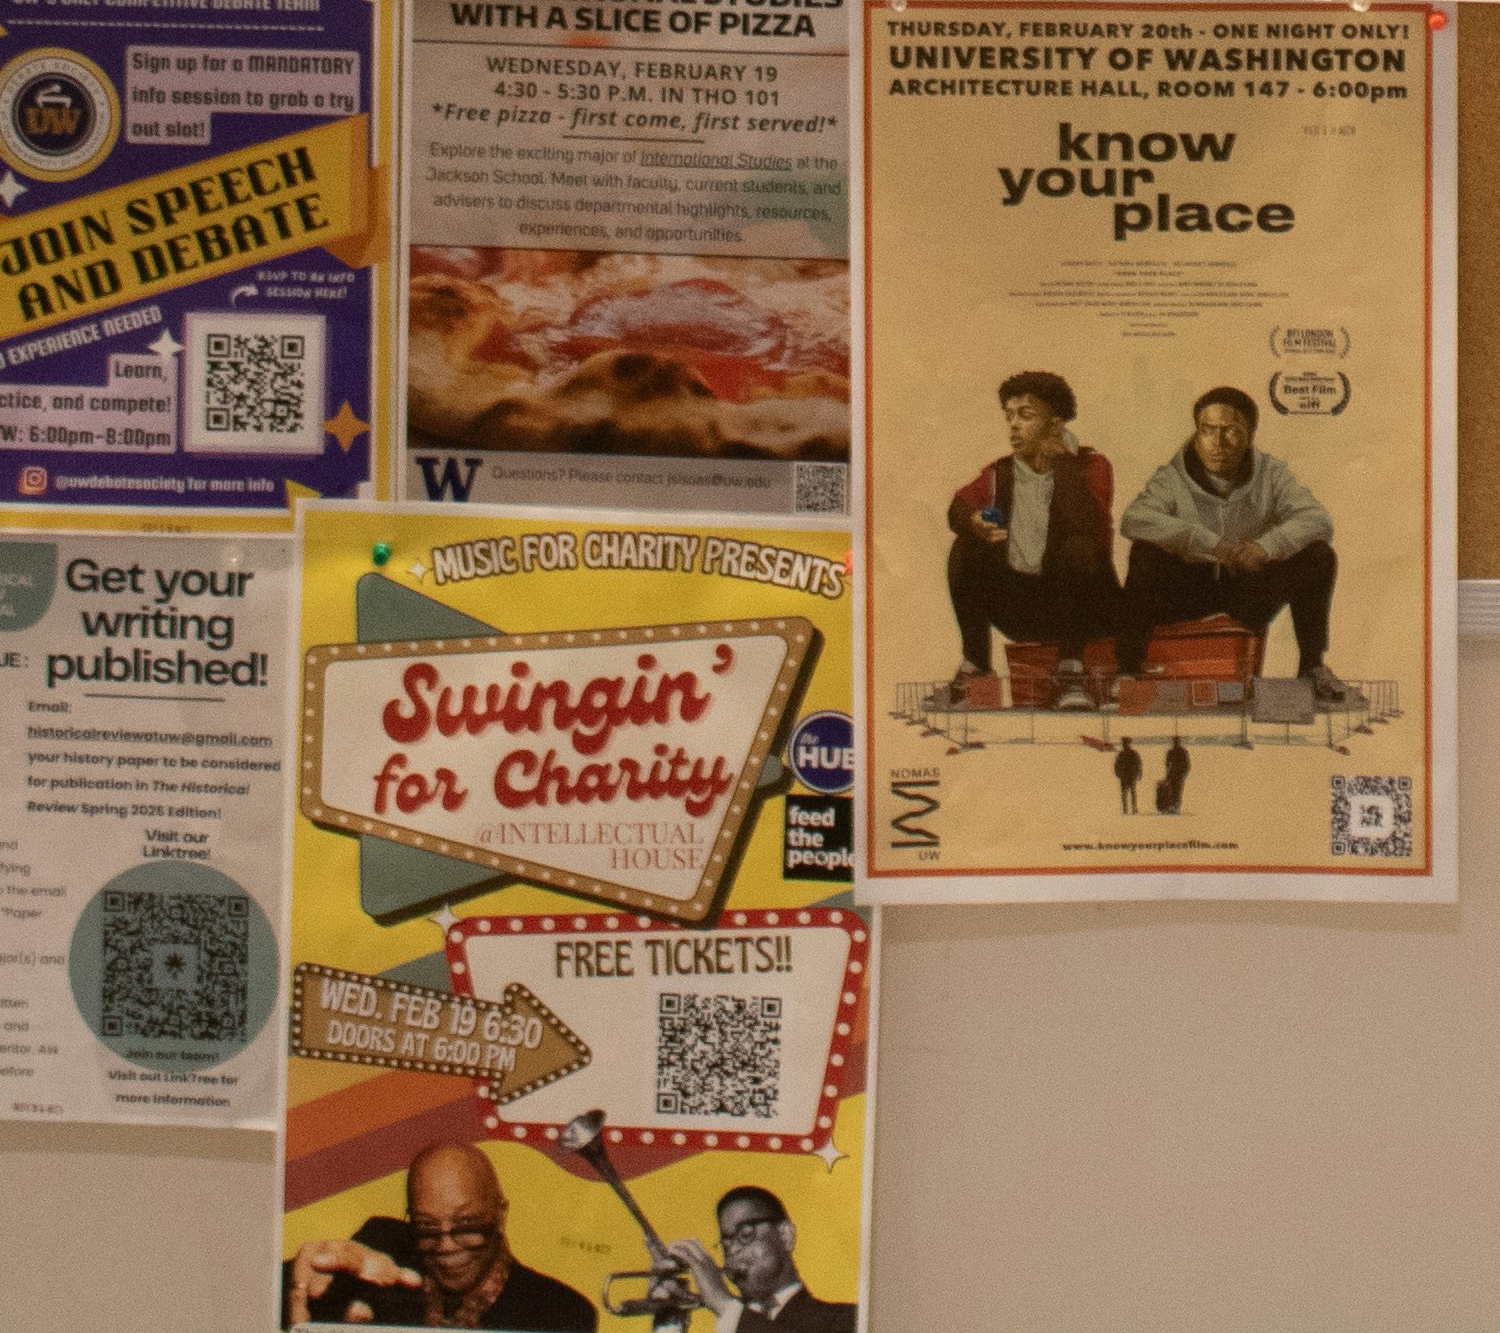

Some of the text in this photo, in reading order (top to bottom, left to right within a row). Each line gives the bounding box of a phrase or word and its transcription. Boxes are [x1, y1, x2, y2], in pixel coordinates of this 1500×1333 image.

[1059, 123, 1235, 162] know
[999, 164, 1156, 206] your
[1113, 194, 1294, 240] place
[65, 558, 254, 602] Get your
[82, 606, 235, 650] writing
[46, 648, 268, 690] published!
[555, 936, 793, 977] FREE TICKETS!!
